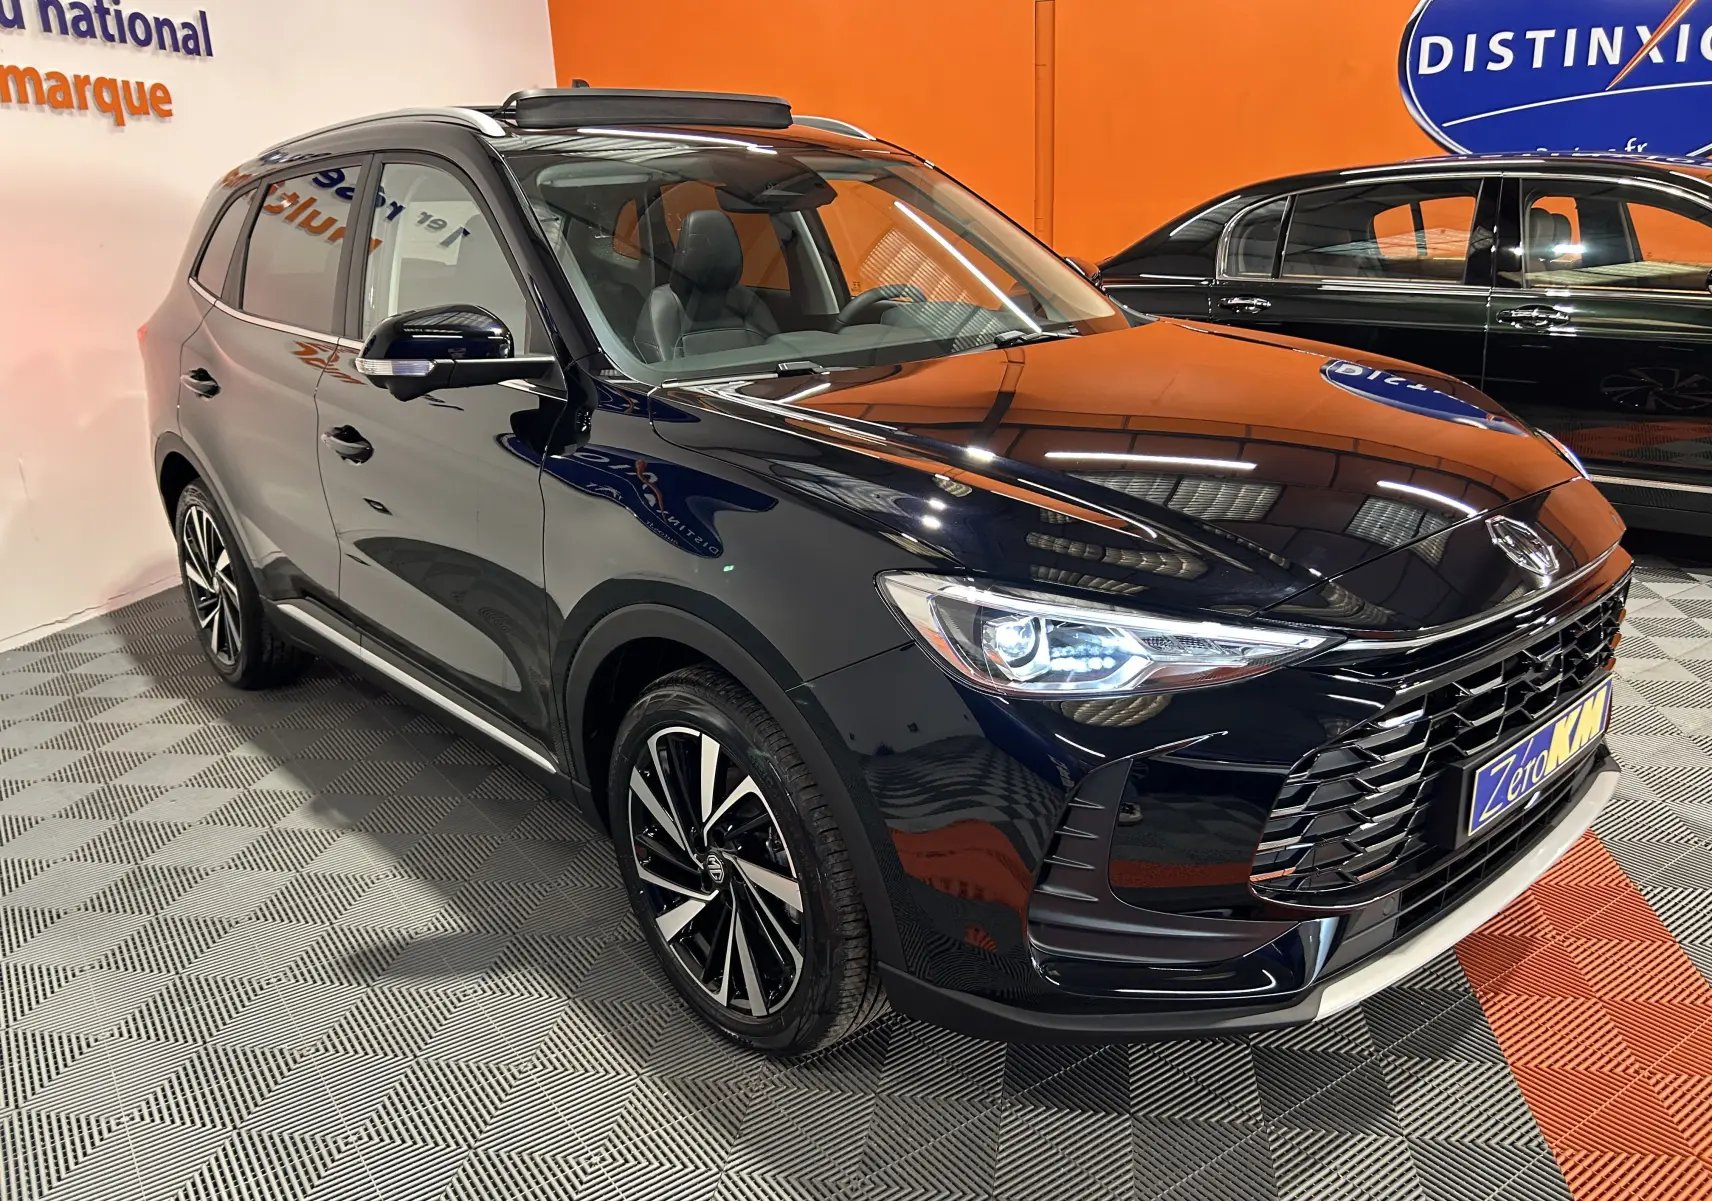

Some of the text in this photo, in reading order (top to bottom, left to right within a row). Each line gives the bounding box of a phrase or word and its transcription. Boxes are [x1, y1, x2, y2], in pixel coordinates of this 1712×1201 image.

[38, 0, 213, 57] national
[0, 64, 173, 127] marque
[708, 857, 724, 881] MG
